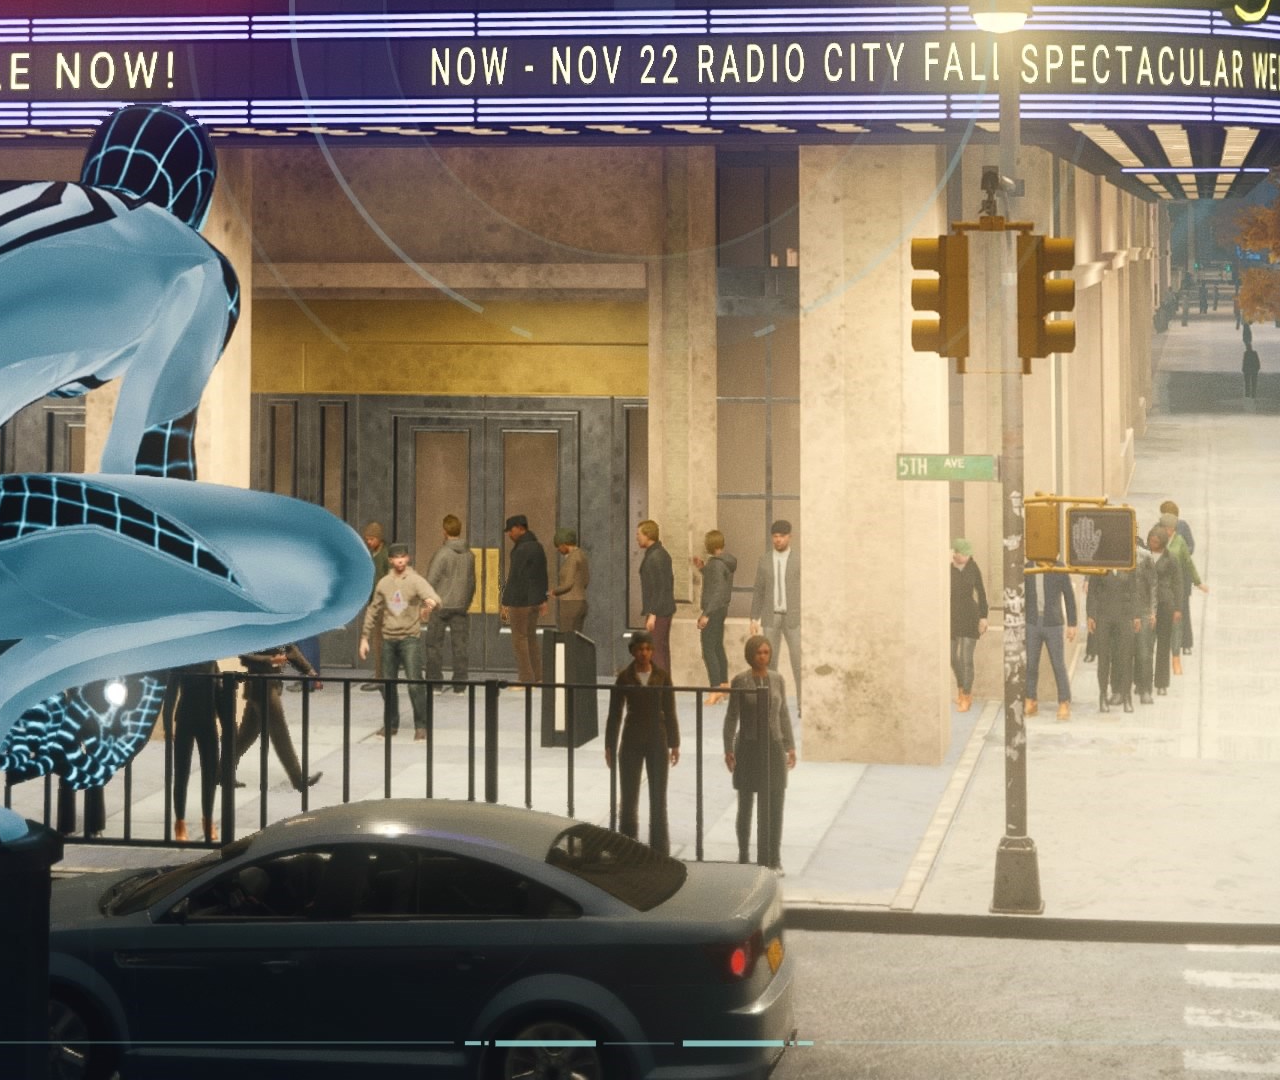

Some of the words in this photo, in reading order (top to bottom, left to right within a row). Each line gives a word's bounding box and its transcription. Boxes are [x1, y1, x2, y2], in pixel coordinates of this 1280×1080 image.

[56, 50, 177, 90] NOW!
[430, 46, 508, 87] NOW
[552, 44, 622, 86] NOV
[639, 44, 680, 85] 22
[697, 43, 806, 84] RADIO
[823, 42, 906, 83] CITY
[1020, 43, 1246, 90] SPECTACULAR
[898, 457, 928, 476] 5TH
[943, 457, 966, 469] AVE
